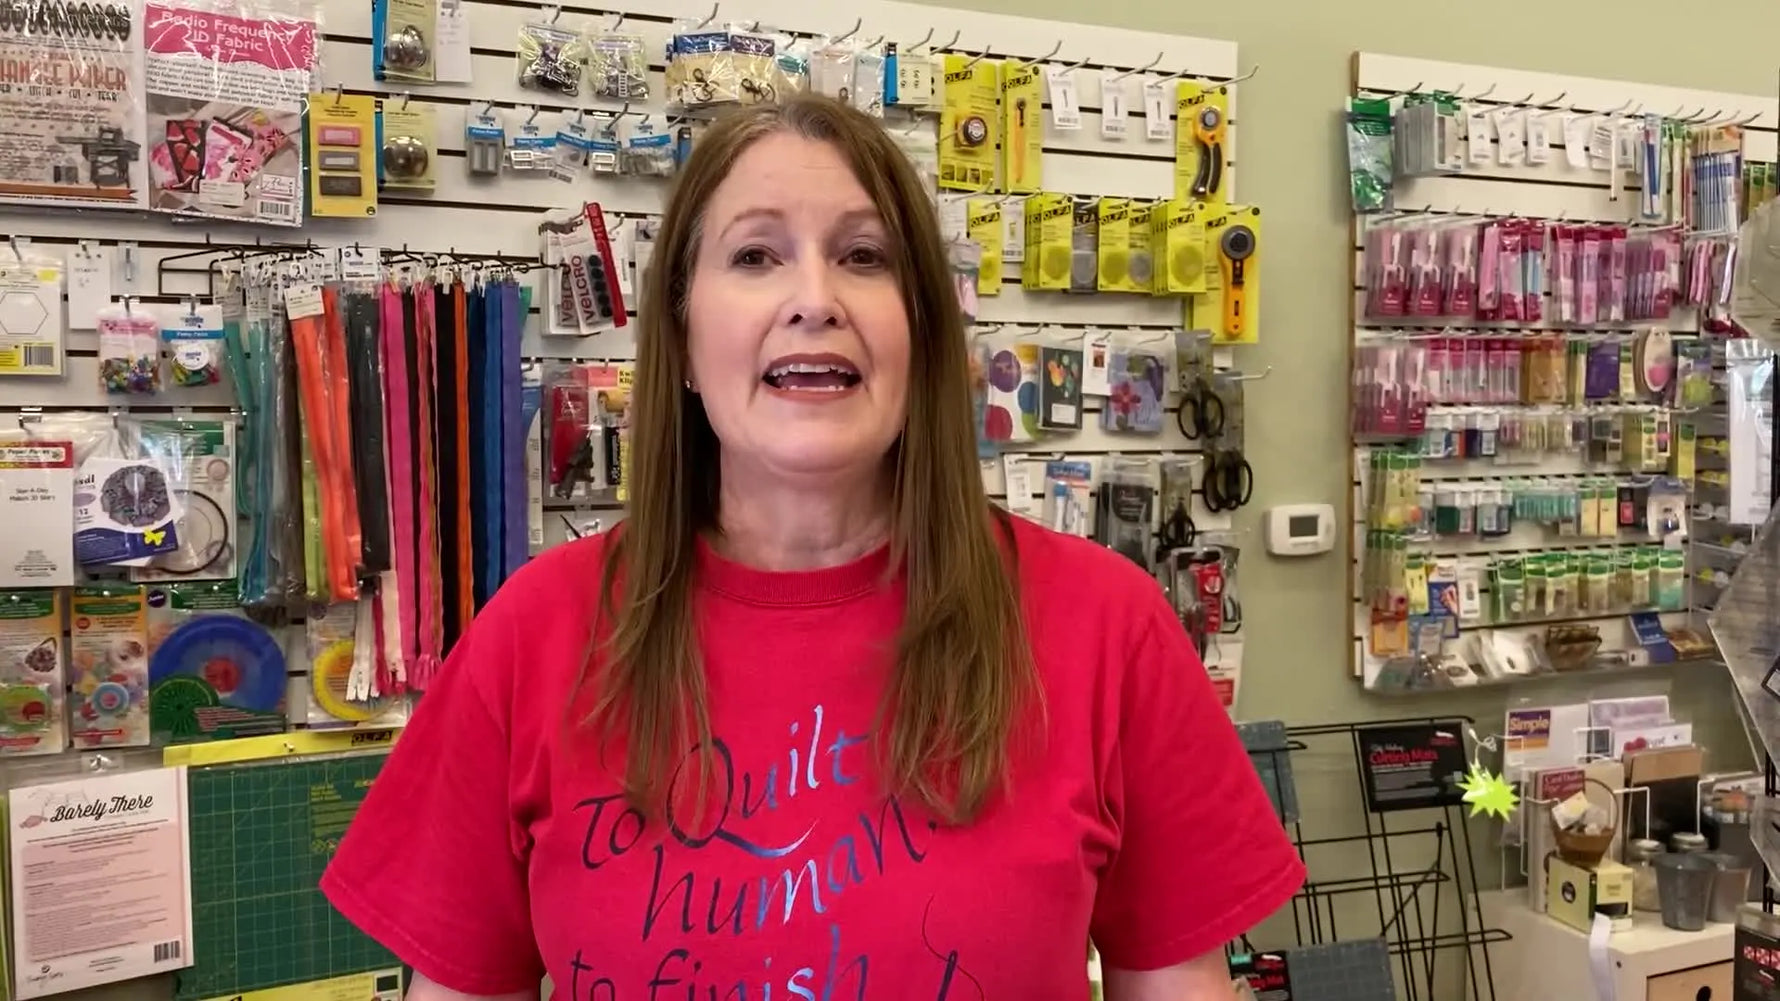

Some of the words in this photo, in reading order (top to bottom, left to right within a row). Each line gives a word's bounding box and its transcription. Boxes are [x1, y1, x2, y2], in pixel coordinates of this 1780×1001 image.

[161, 10, 208, 29] Radio
[214, 19, 297, 45] Frequency
[193, 31, 210, 43] ID
[216, 34, 265, 52] Fabric
[571, 255, 596, 322] VELCRO
[351, 730, 394, 747] OLFA
[1510, 717, 1550, 733] Simple
[571, 793, 647, 869] To
[666, 704, 871, 857] Quilt
[49, 798, 107, 822] Barely
[108, 794, 154, 814] There
[648, 924, 869, 1001] finish
